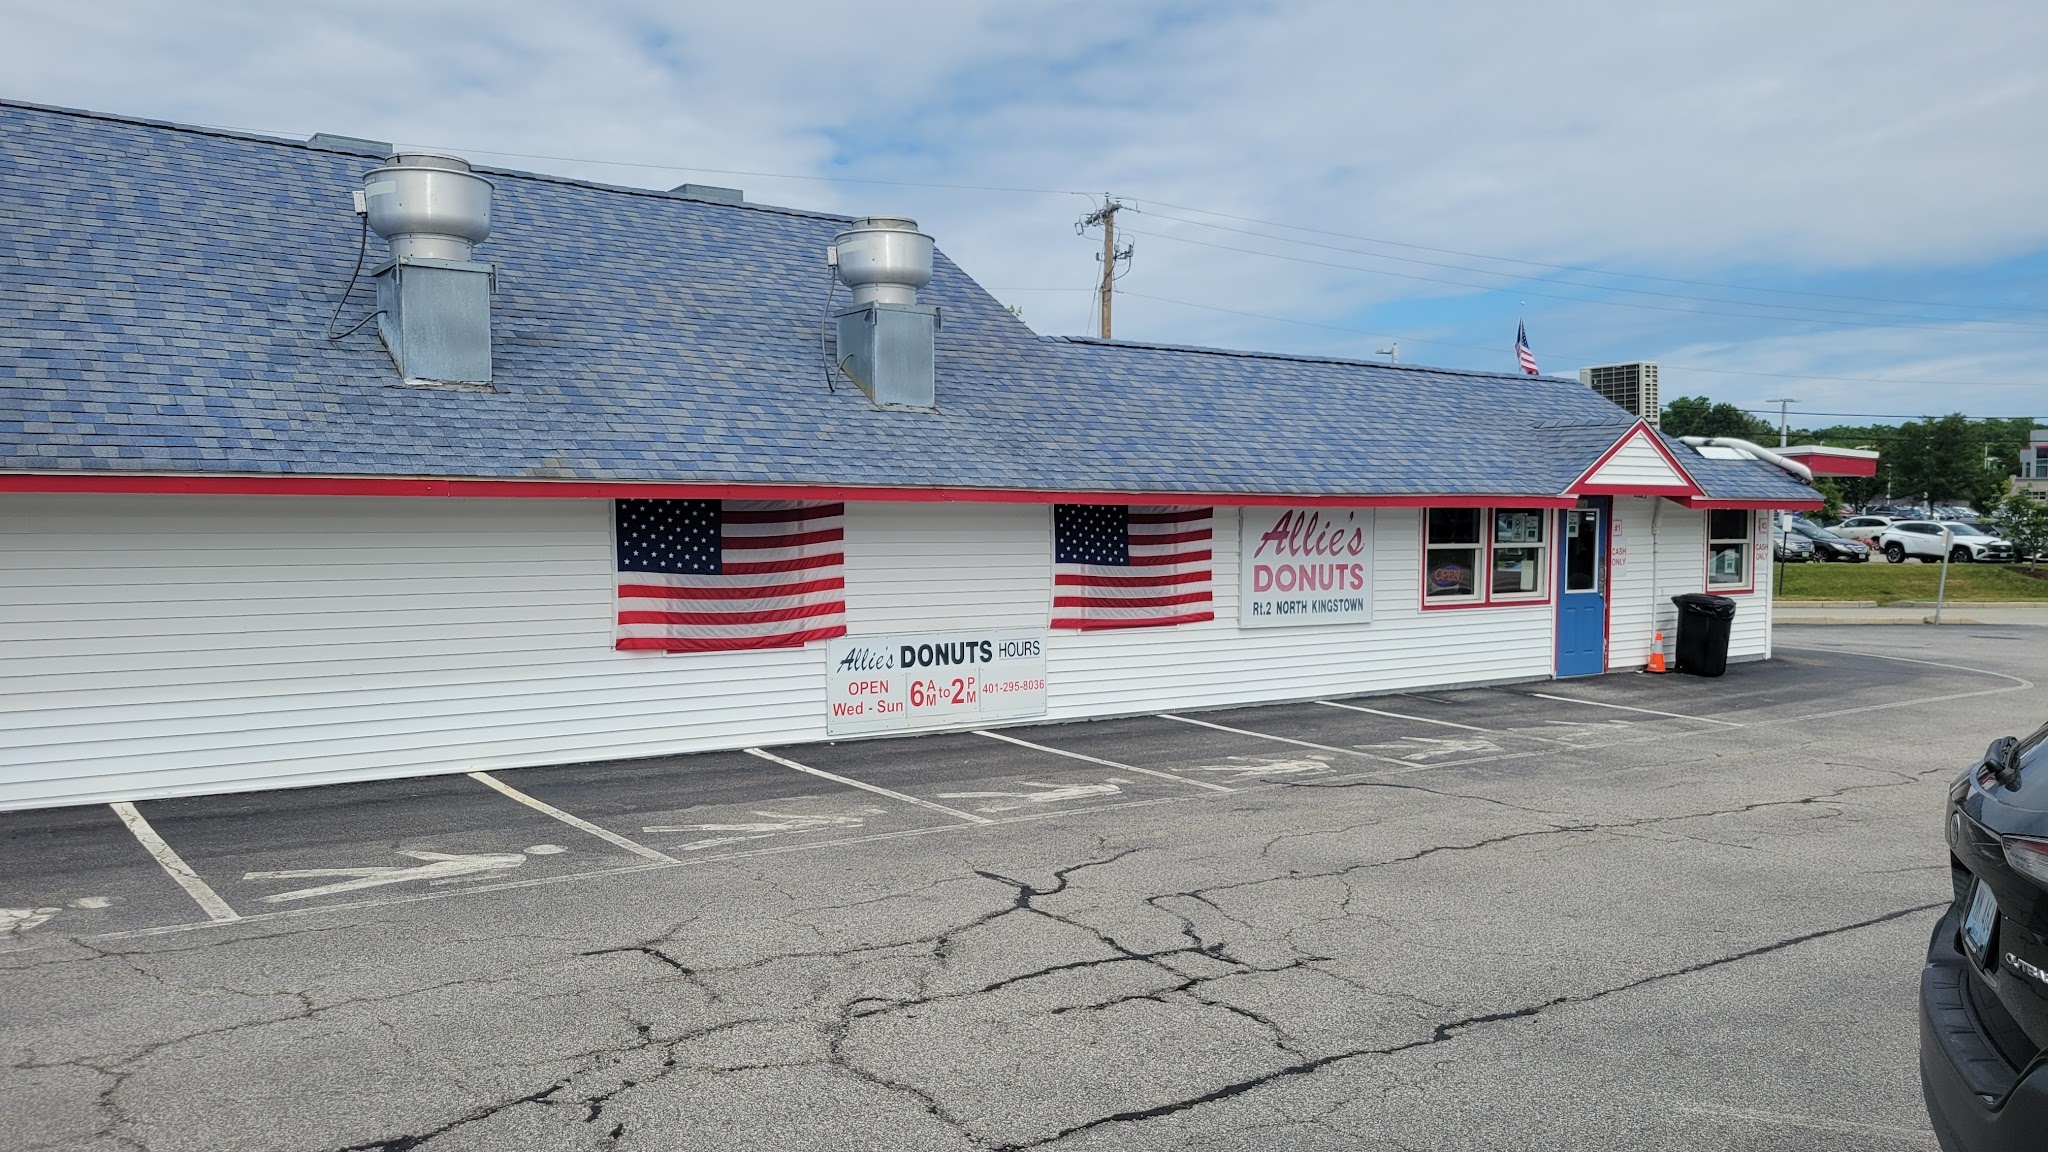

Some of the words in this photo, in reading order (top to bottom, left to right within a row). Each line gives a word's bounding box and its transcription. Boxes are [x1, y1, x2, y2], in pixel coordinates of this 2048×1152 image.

[1253, 509, 1365, 559] Allie's
[1611, 547, 1627, 556] CASH
[1755, 543, 1768, 551] CASH
[1611, 558, 1626, 567] ONLY
[1253, 563, 1364, 592] DONUTS
[1434, 568, 1461, 581] OPEN
[1252, 602, 1272, 616] Rt.2
[1276, 600, 1307, 615] NORTH
[1311, 597, 1364, 613] KINGSTOWN
[836, 646, 895, 674] Allie's
[900, 640, 993, 669] DONUTS
[998, 640, 1041, 658] HOURS
[848, 679, 889, 696] OPEN
[909, 680, 925, 707] 6
[938, 686, 951, 699] to
[951, 678, 965, 705] 2
[982, 679, 1045, 694] 401-295-8036
[832, 701, 864, 717] Wed
[877, 699, 904, 713] Sun
